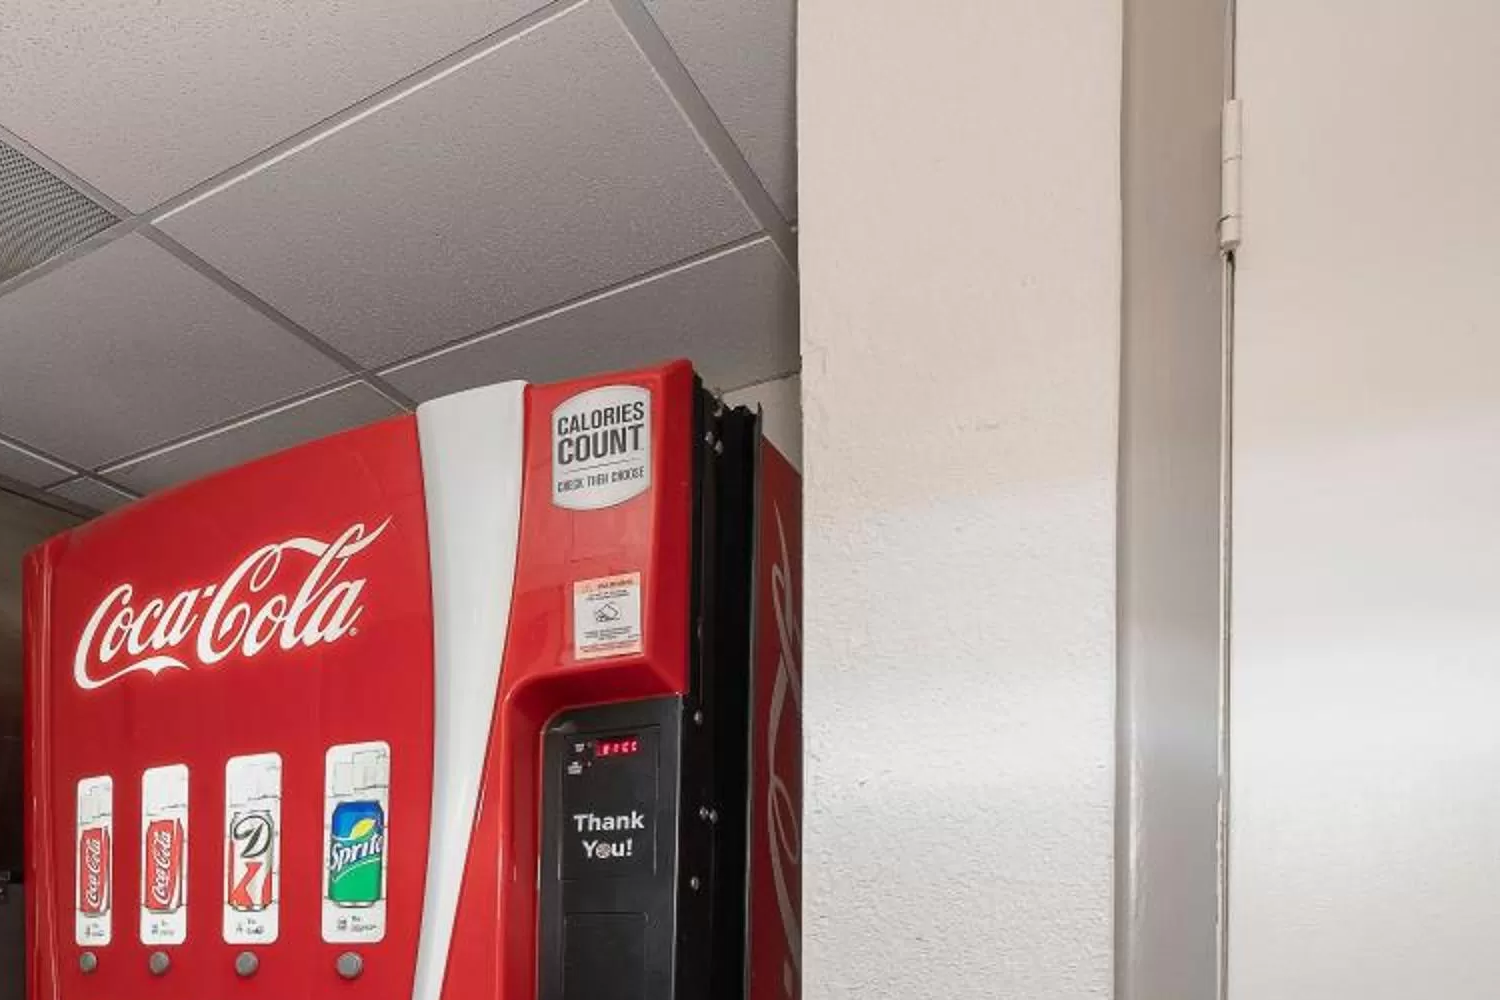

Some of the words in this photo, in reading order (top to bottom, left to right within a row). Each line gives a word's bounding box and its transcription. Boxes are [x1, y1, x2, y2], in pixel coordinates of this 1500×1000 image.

[558, 401, 645, 436] CALORIES
[558, 423, 645, 465] COUNT
[75, 514, 394, 690] Coca-Cola
[574, 811, 645, 832] Thank
[582, 837, 633, 859] You!
